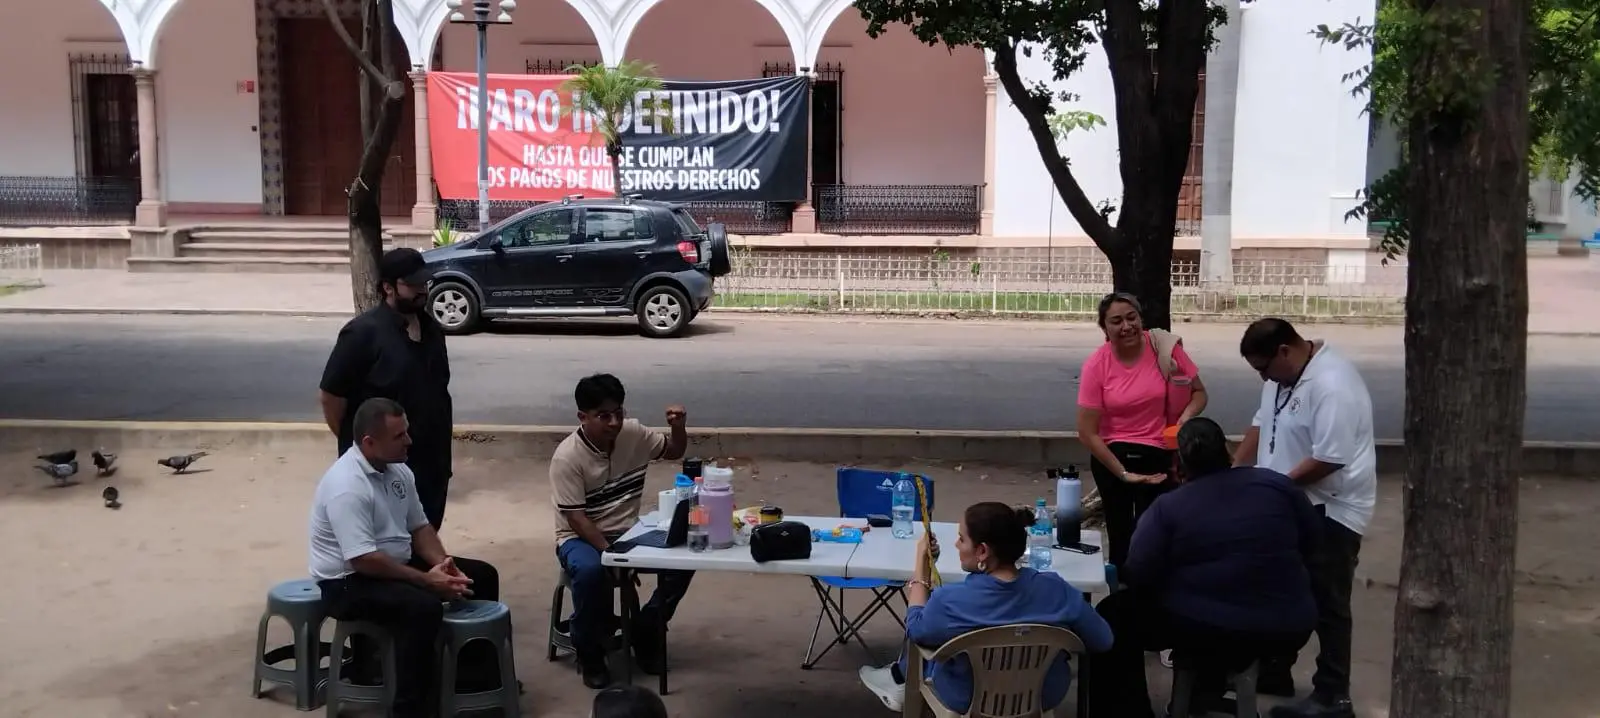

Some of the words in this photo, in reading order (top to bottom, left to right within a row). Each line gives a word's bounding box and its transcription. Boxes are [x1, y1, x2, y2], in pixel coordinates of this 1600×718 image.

[523, 144, 574, 167] HASTA
[579, 145, 612, 167] QUE
[618, 146, 635, 168] SE
[638, 146, 714, 168] CUMPLAN
[477, 166, 505, 188] OS
[510, 167, 565, 189] PAGOS
[566, 168, 589, 189] DE
[677, 168, 761, 191] DERECHOS
